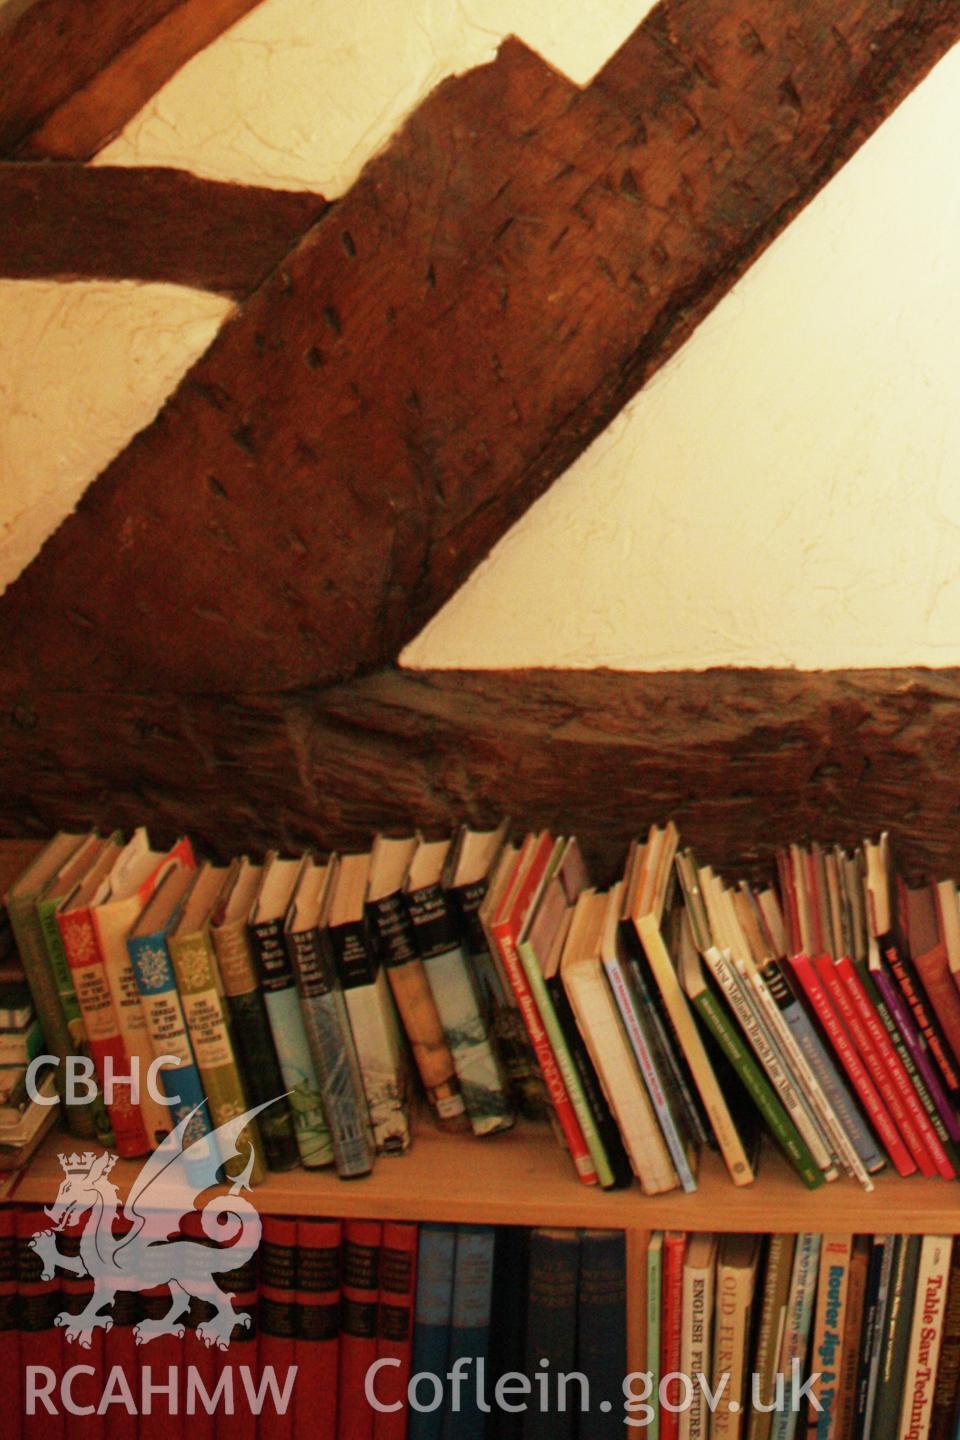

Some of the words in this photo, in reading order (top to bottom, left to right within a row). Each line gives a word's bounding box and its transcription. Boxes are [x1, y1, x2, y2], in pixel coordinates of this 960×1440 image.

[845, 975, 872, 1019] MIDLANDS
[498, 934, 528, 992] Railways
[519, 993, 545, 1041] through
[537, 1042, 568, 1104] LONDON
[711, 958, 731, 983] West
[724, 981, 756, 1026] Midlands
[746, 1022, 773, 1059] Branch
[764, 1055, 784, 1079] Line
[776, 1077, 801, 1110] Album
[827, 1019, 841, 1037] THE
[867, 1019, 883, 1041] EAST
[876, 1002, 896, 1032] DEVON
[842, 1050, 861, 1077] STEAM
[878, 1040, 891, 1056] THE
[897, 1044, 916, 1074] STEAM
[867, 1053, 886, 1082] STEAM
[892, 1067, 911, 1095] STEAM
[856, 1077, 880, 1112] MIDLAND
[881, 1083, 904, 1119] MIDLAND
[911, 1074, 935, 1114] WESTERN
[875, 1112, 897, 1145] LONDON
[906, 1095, 929, 1131] MIDLAND
[930, 1114, 948, 1142] GREAT
[900, 1119, 922, 1154] LONDON
[924, 1130, 945, 1164] LONDON
[691, 1278, 704, 1342] ENGLISH
[720, 1275, 736, 1316] OLD
[825, 1265, 845, 1328] Router
[921, 1273, 943, 1325] Table
[818, 1331, 840, 1367] Jigs
[916, 1326, 936, 1367] Saw
[689, 1351, 702, 1438] FURNITURE
[714, 1325, 734, 1434] FURNITURE
